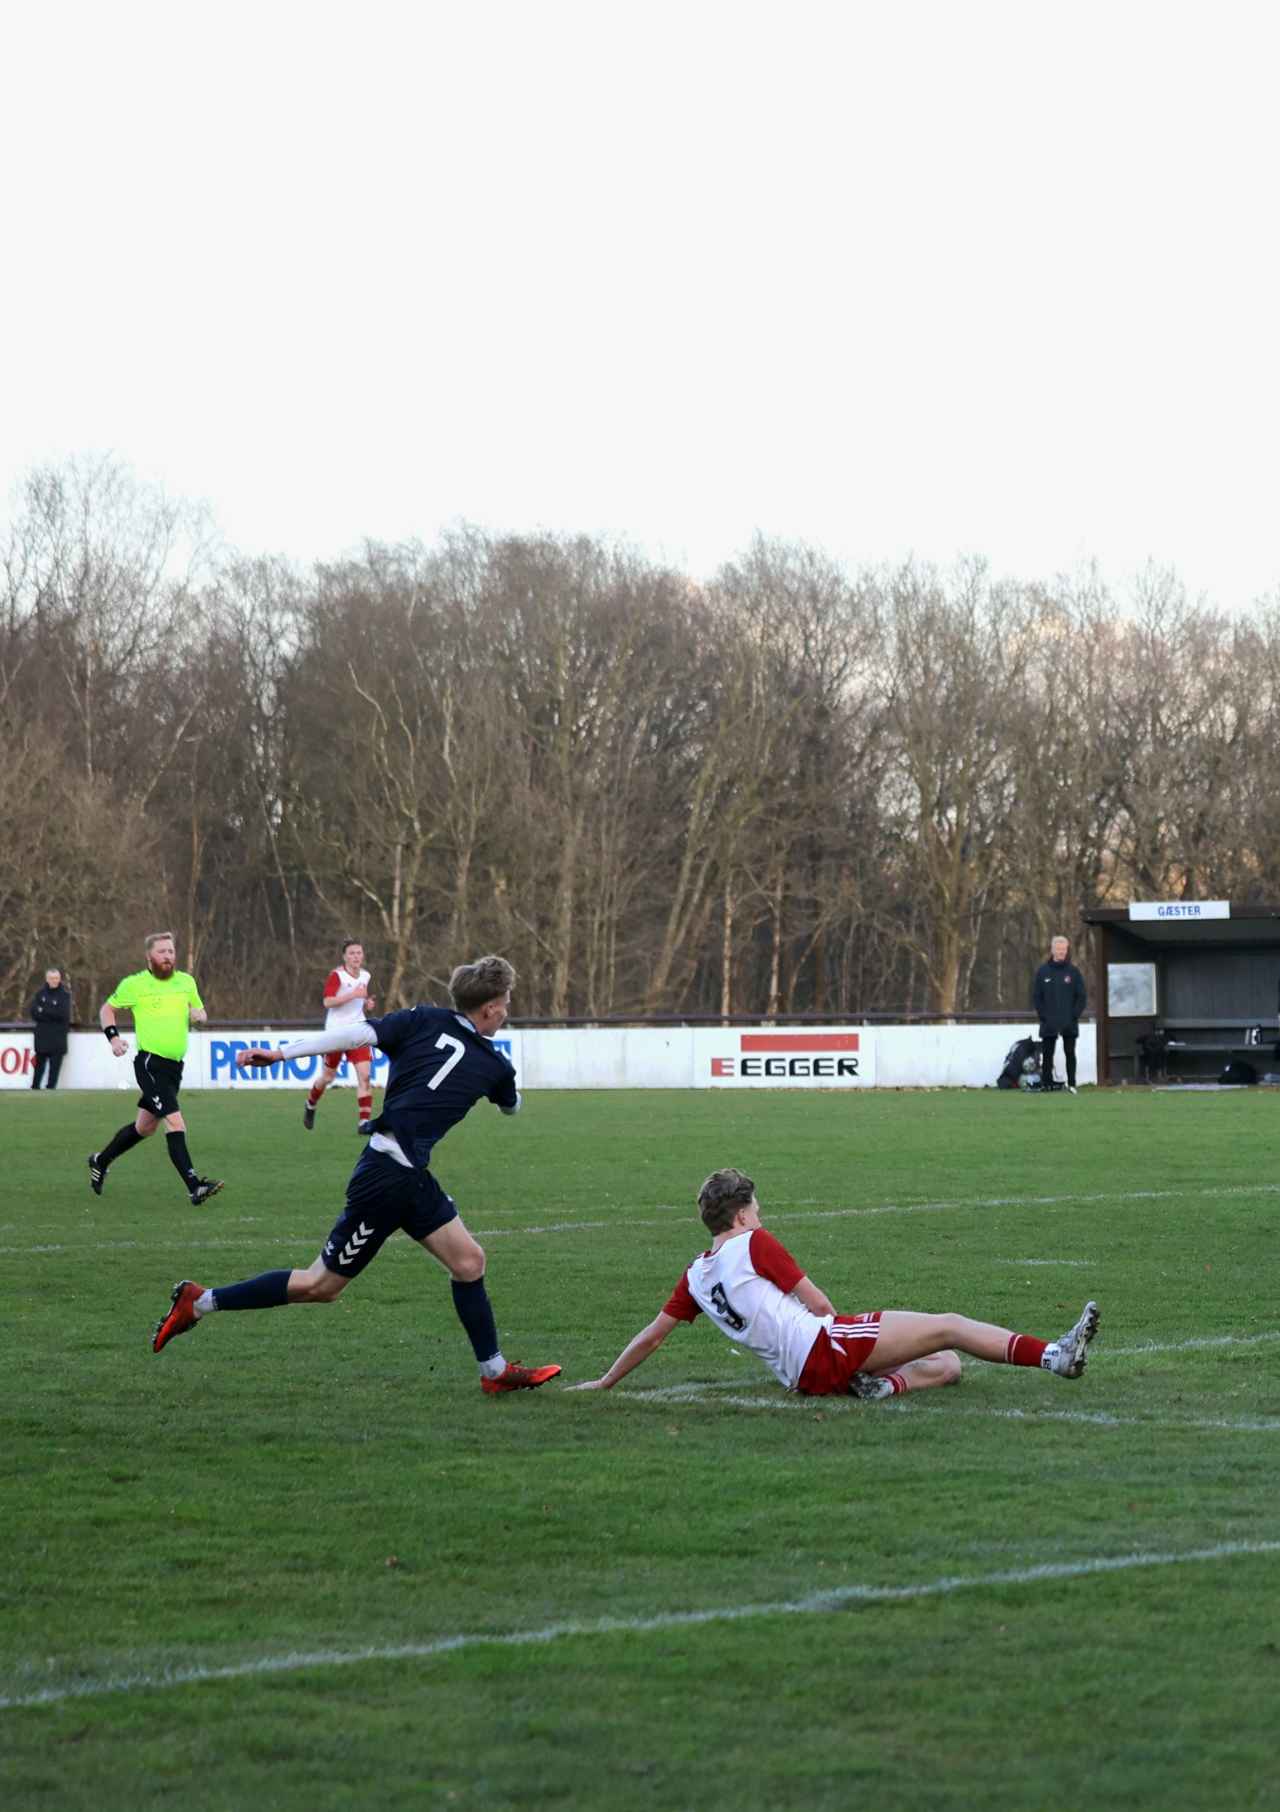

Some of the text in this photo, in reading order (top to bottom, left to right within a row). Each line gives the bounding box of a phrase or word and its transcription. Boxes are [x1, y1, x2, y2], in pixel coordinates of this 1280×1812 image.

[1157, 905, 1201, 917] GÆSTER
[427, 1032, 466, 1091] 7
[740, 1057, 859, 1077] EGGER
